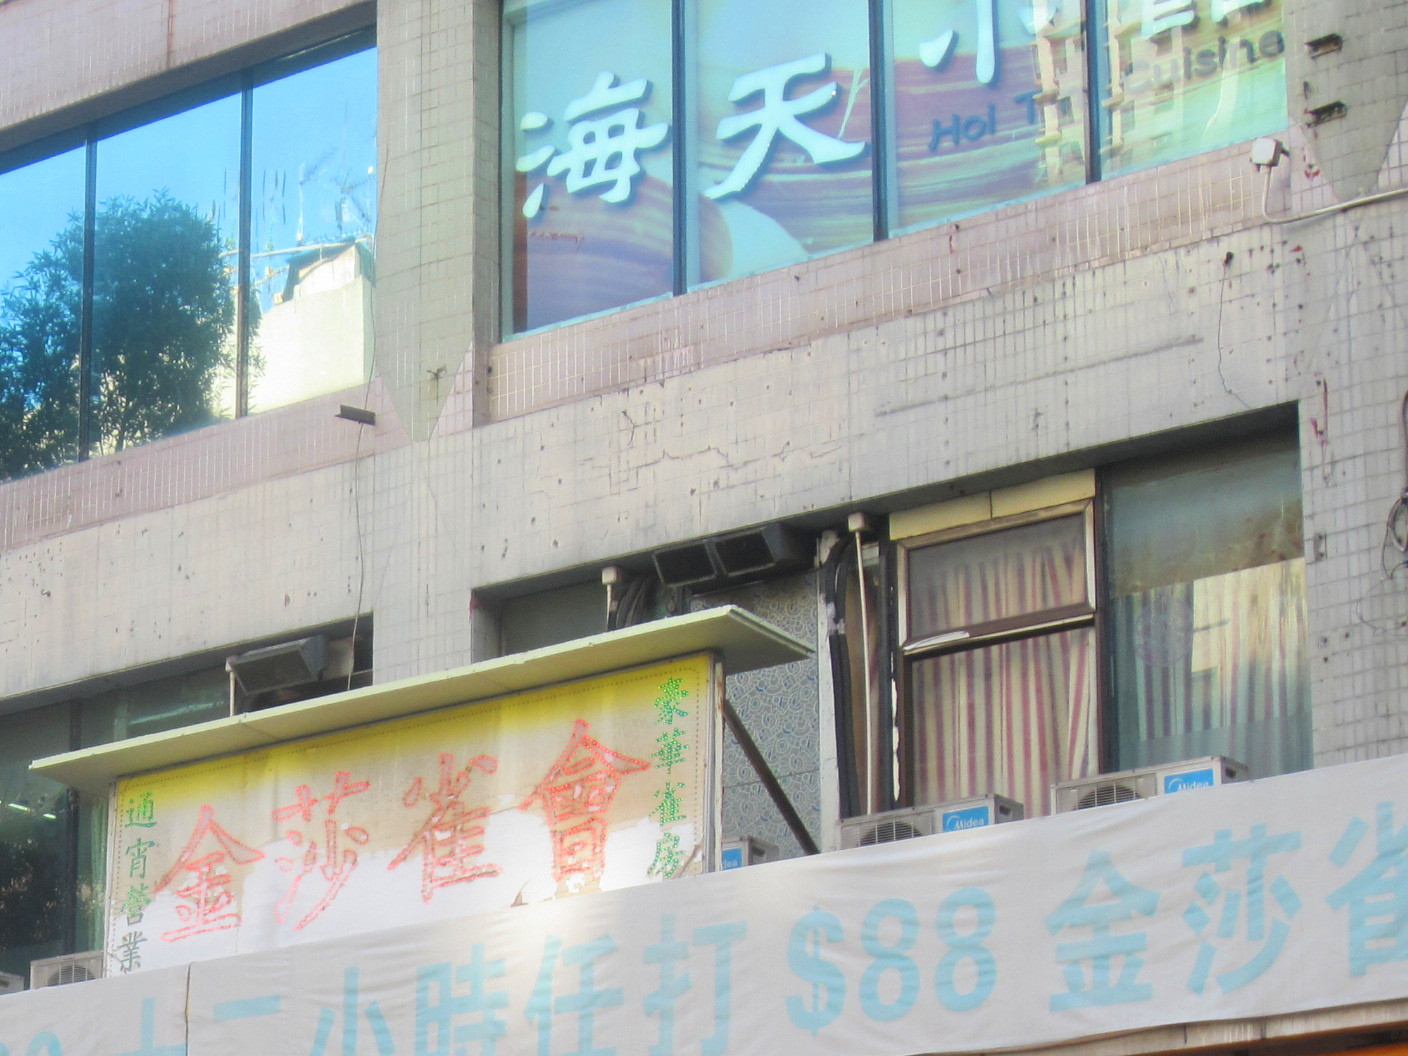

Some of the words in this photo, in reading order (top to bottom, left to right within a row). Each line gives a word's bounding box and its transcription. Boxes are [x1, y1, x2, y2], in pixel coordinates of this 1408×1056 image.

[154, 717, 651, 943] 金莎雀會
[646, 676, 692, 879] 豪華雀房
[954, 818, 985, 830] Midea
[117, 791, 158, 975] 通宵營業
[790, 884, 998, 1036] $88
